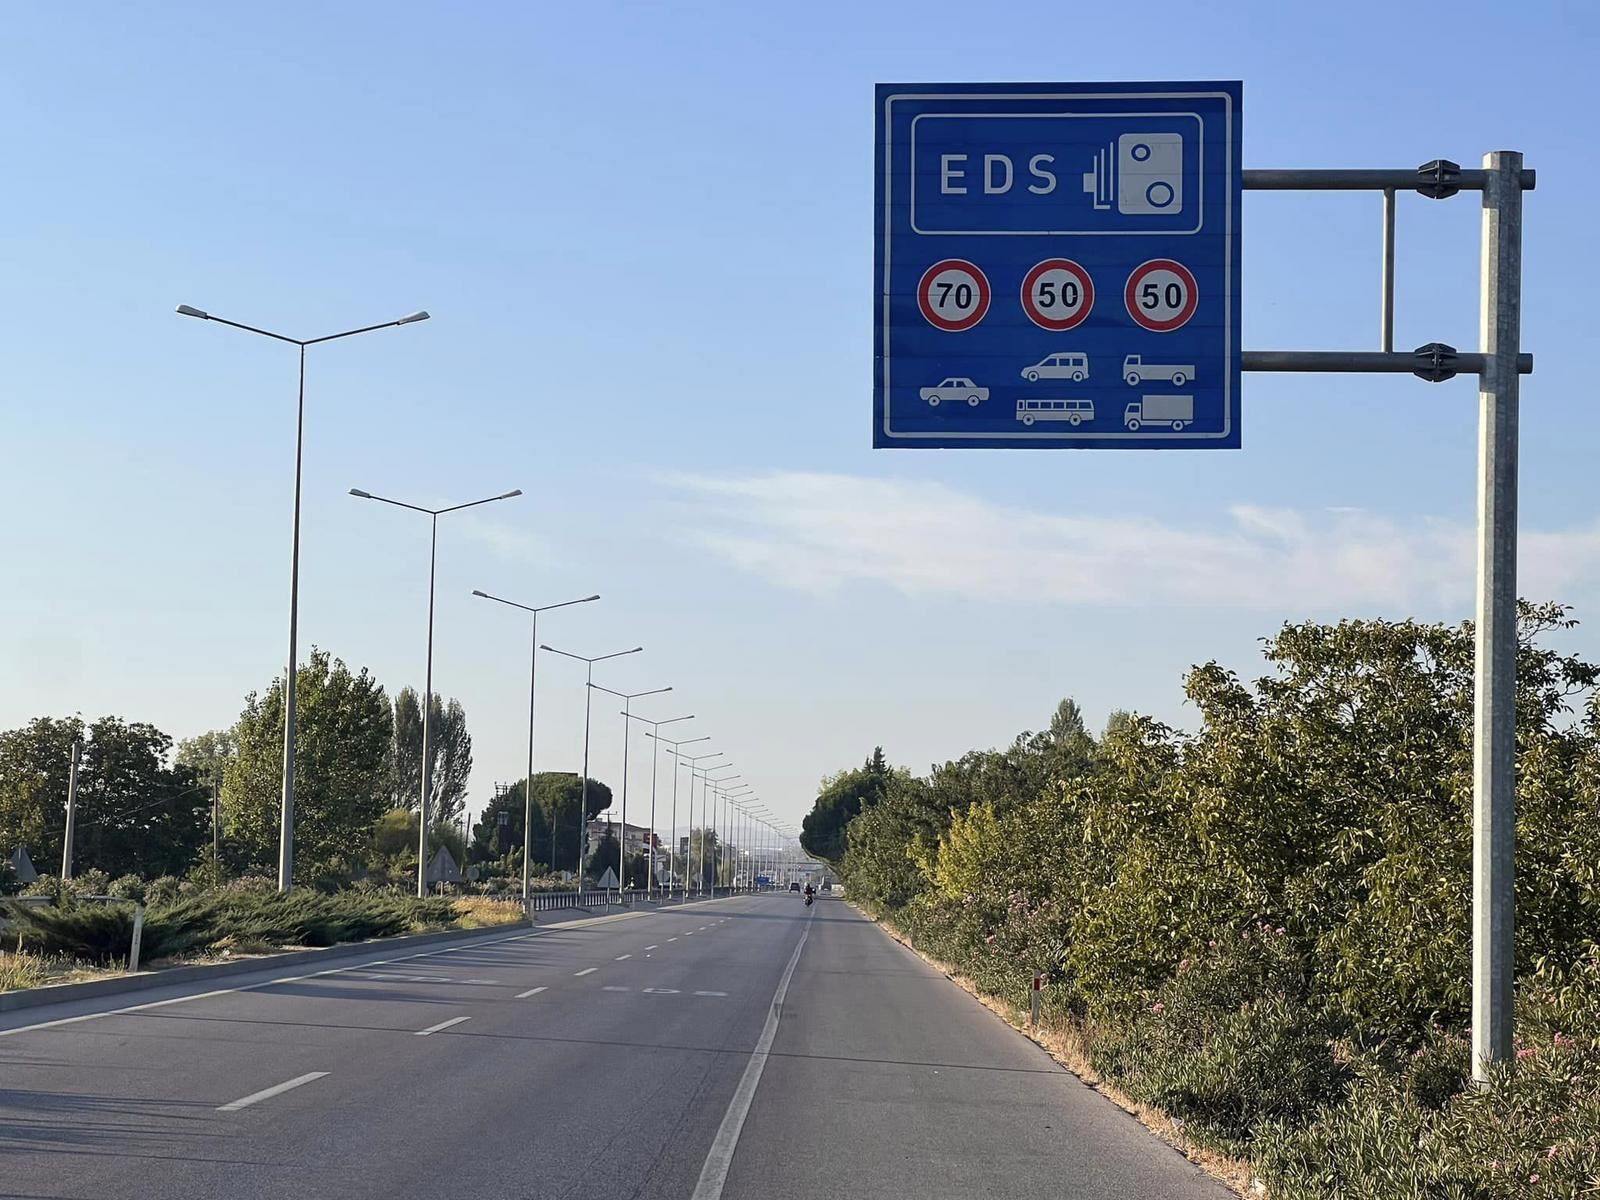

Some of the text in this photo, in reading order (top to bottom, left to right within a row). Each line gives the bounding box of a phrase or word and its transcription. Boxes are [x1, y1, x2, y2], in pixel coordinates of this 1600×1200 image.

[936, 282, 972, 309] 70
[1038, 281, 1078, 308] 50
[1141, 282, 1182, 309] 50
